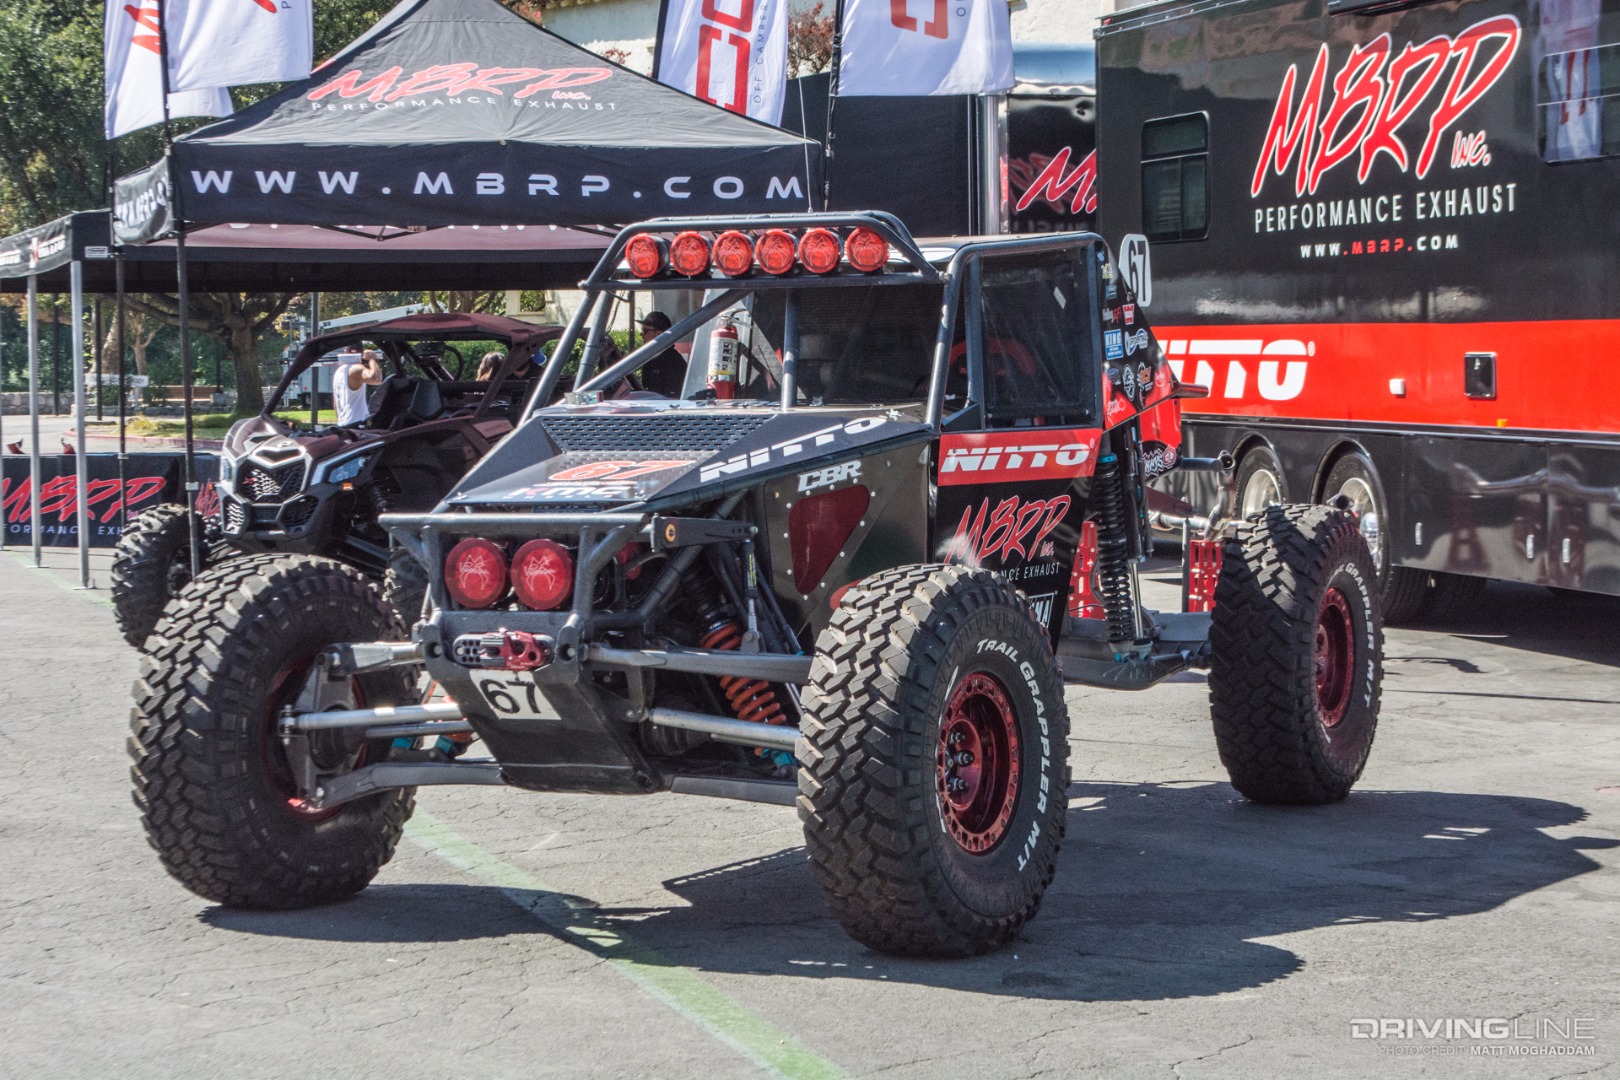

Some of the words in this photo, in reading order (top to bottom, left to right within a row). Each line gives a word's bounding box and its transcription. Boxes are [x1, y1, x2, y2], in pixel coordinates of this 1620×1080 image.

[755, 4, 769, 65] CAMBER
[309, 62, 613, 103] MBRP
[311, 96, 496, 112] PERFORMANCE
[513, 97, 617, 112] EXHAUST
[753, 76, 762, 104] OFF
[1250, 13, 1522, 198] MBRP
[1254, 195, 1402, 233] PERFORMANCE
[1416, 183, 1517, 220] EXHAUST
[1128, 237, 1146, 302] 67
[1105, 332, 1122, 346] KING
[1157, 339, 1308, 401] ITTO
[549, 459, 698, 481] 67
[700, 416, 887, 483] NITTO
[941, 443, 1090, 473] NITTO
[797, 460, 863, 492] CBR
[943, 494, 1072, 567] MBRP
[1023, 562, 1060, 579] EXHAUST
[1345, 562, 1375, 650] GRAPPLER
[976, 638, 1020, 663] TRAIL
[480, 679, 541, 714] 67
[1019, 661, 1049, 814] GRAPPLER
[1018, 821, 1041, 872] M/T
